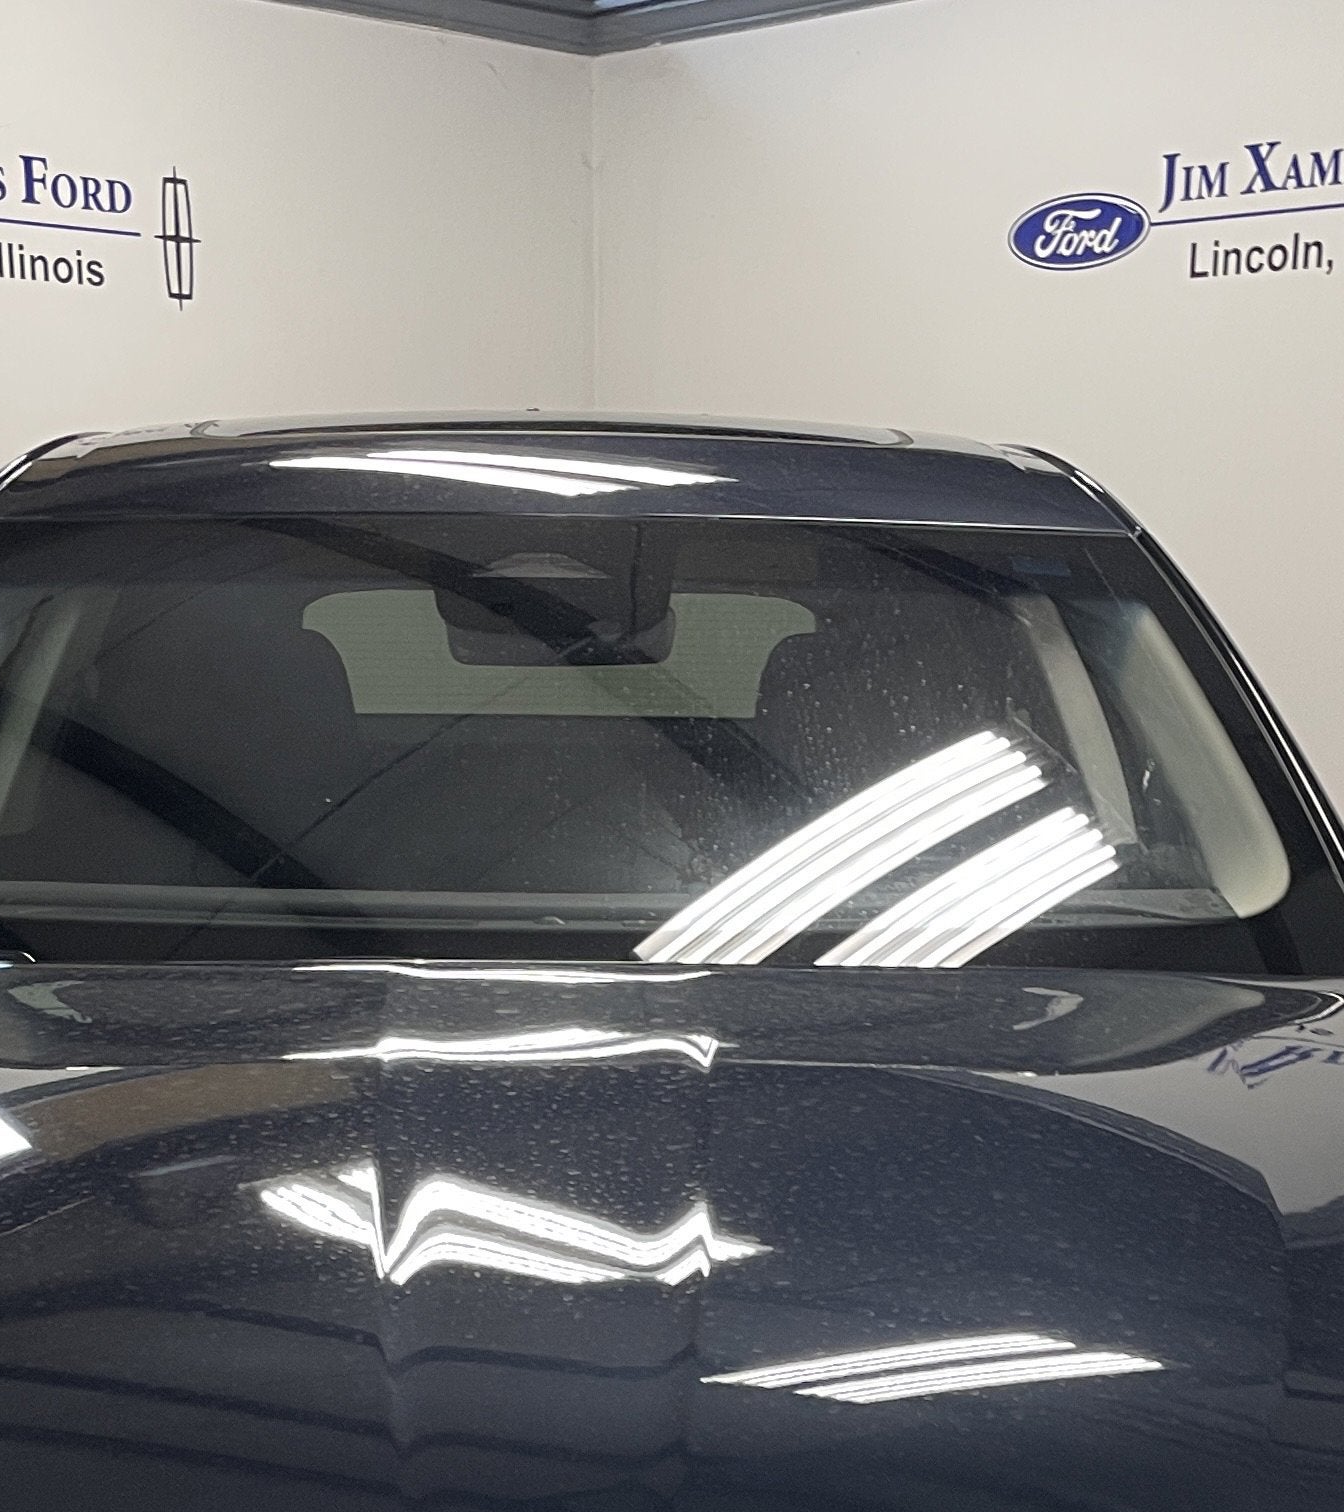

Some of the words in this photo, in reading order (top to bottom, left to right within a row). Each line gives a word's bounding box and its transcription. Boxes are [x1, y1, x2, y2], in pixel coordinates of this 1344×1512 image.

[20, 154, 133, 215] FORD
[1158, 152, 1230, 213] JIM
[1034, 209, 1120, 259] Ford
[1189, 232, 1334, 279] Lincoln,
